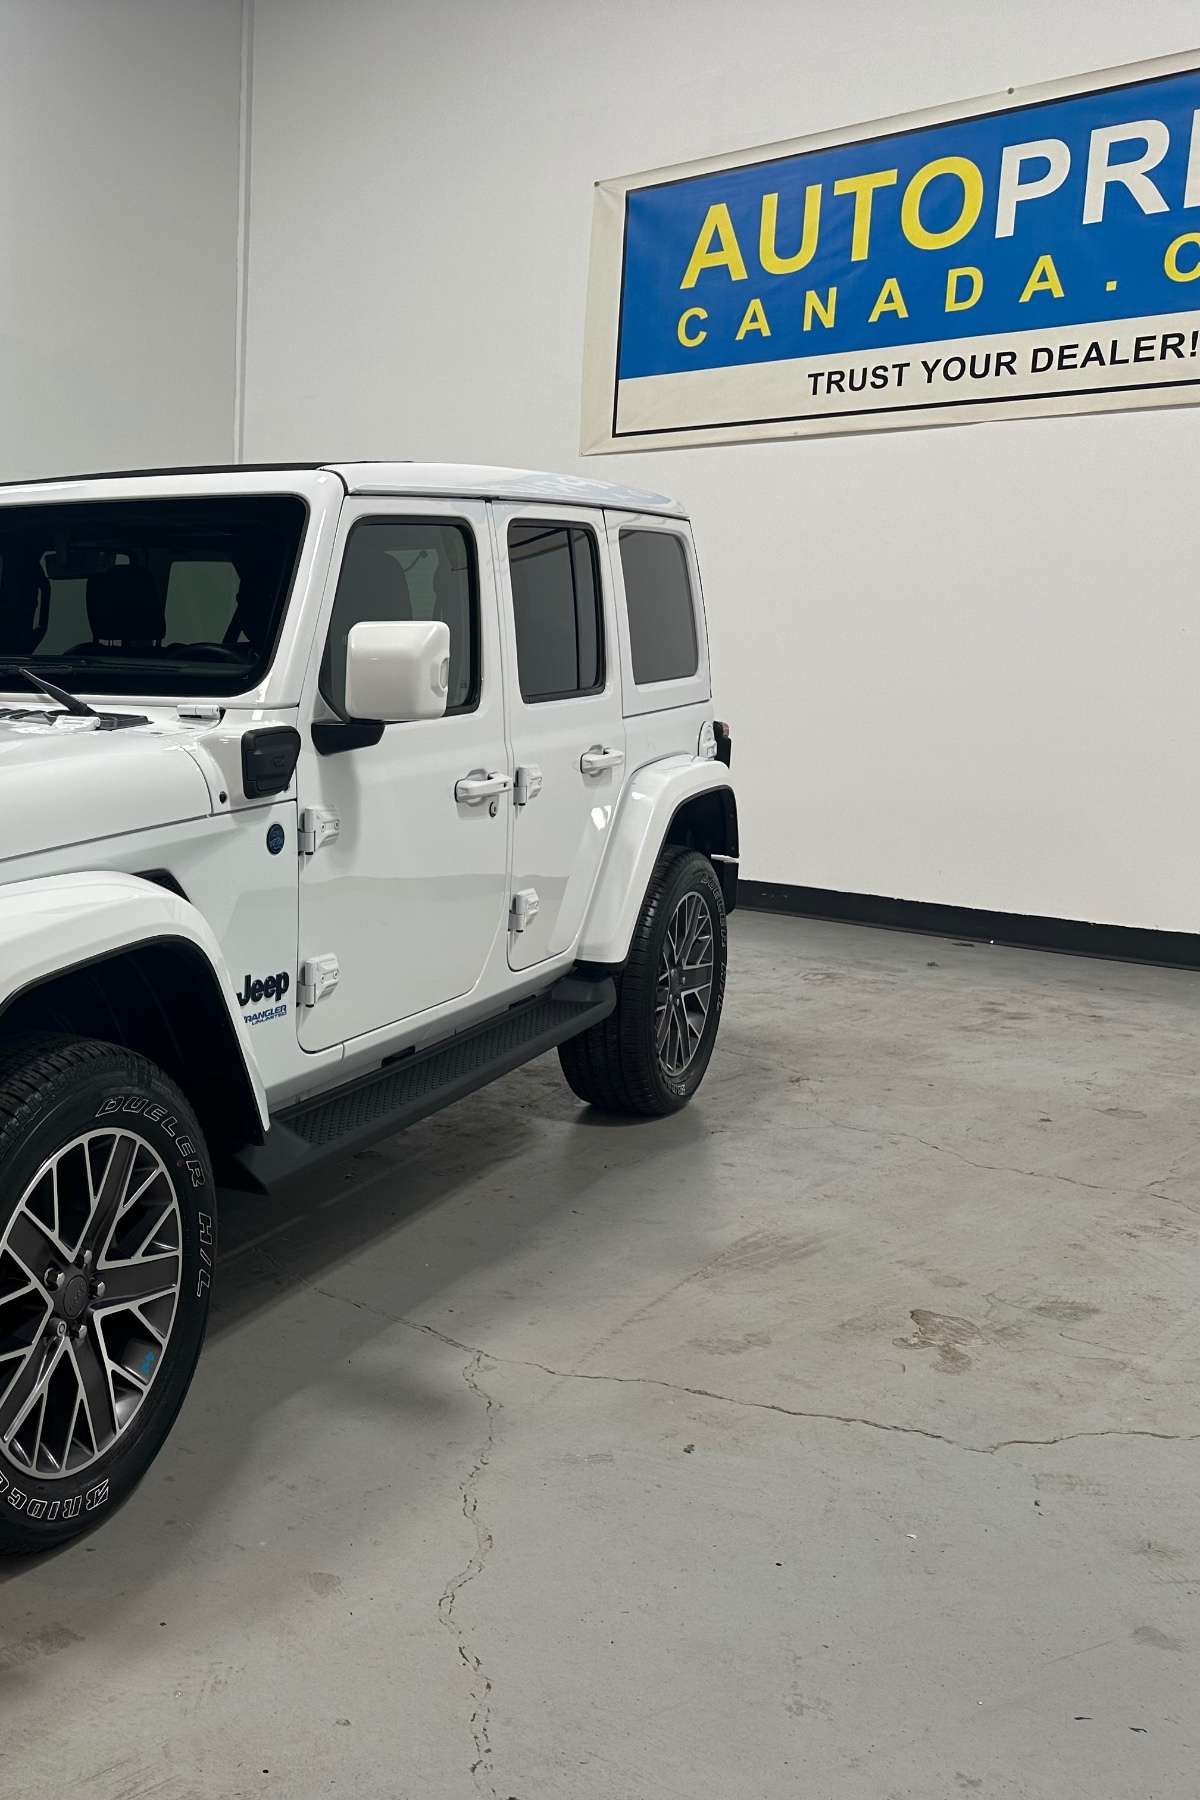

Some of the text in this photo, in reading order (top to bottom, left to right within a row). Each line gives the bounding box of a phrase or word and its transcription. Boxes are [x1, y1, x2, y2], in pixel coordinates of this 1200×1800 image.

[808, 330, 1200, 396] TRUST YOUR DEALER!
[236, 971, 290, 1007] Jeep
[244, 1004, 287, 1024] RANGLER
[96, 1096, 213, 1298] DUELER H/L
